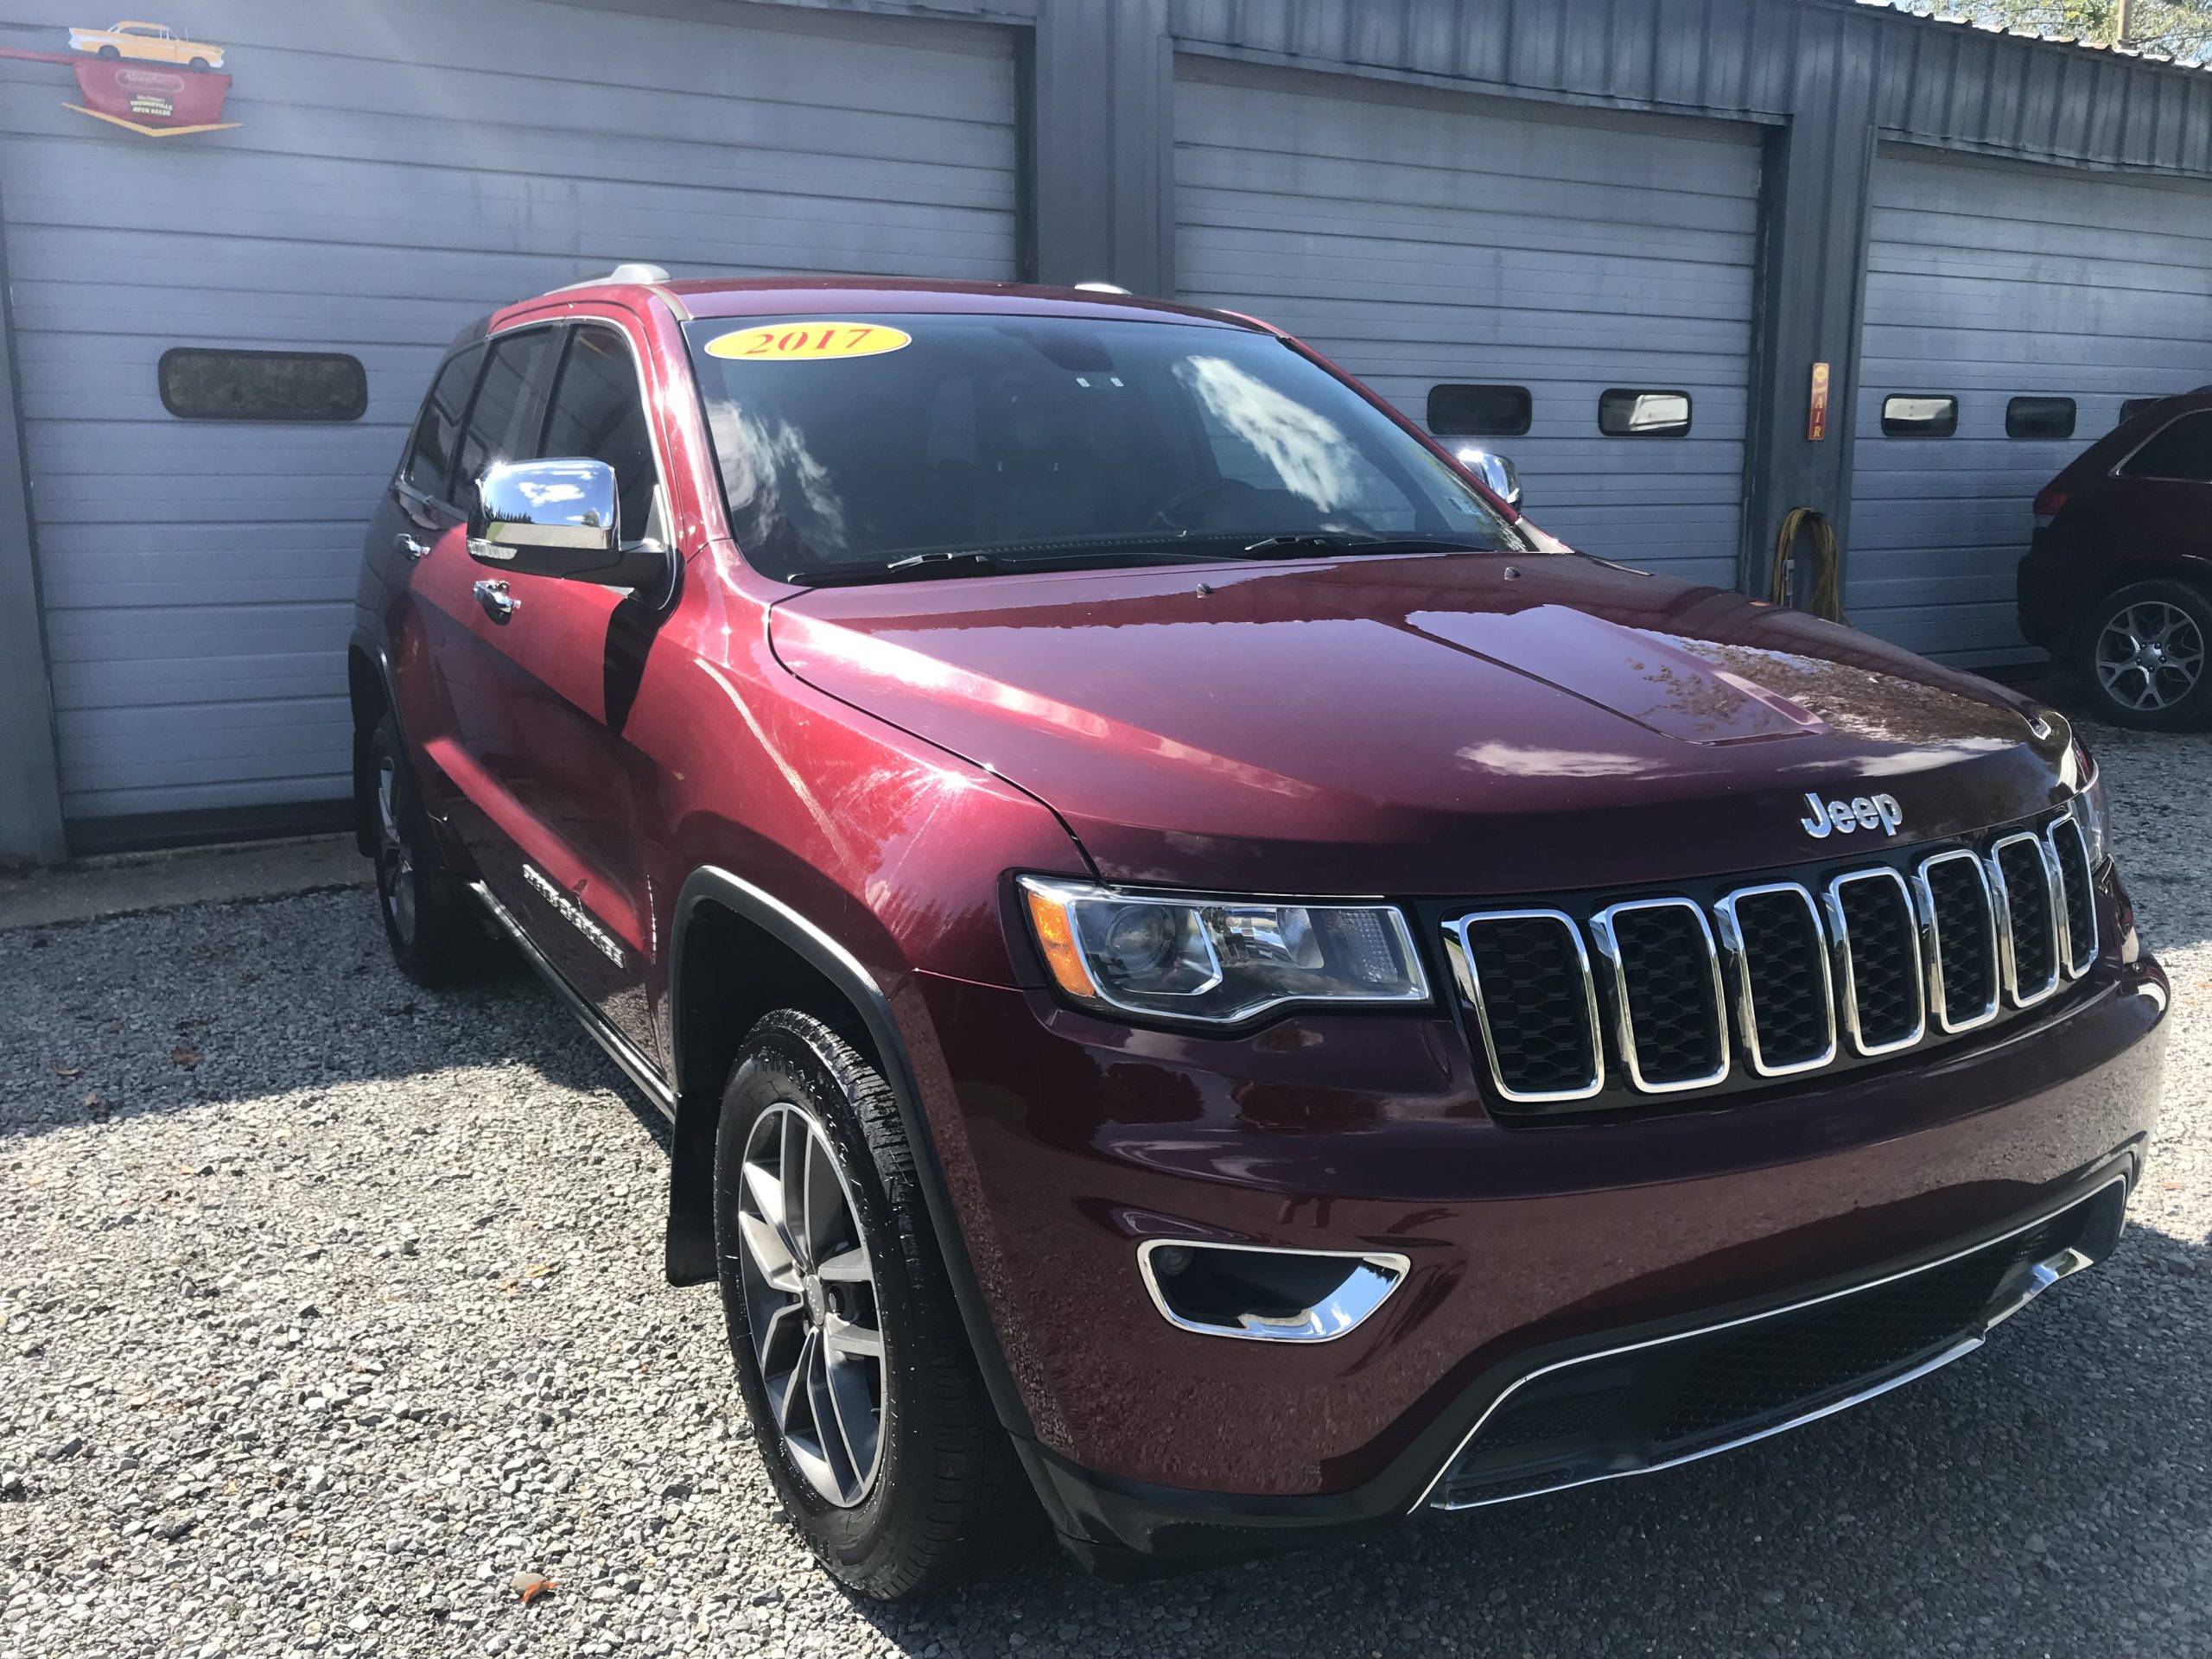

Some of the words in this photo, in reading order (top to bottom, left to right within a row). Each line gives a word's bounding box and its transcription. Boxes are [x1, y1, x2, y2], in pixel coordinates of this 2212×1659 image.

[744, 328, 874, 355] 2017
[1813, 397, 1823, 437] AIR
[1800, 792, 1904, 838] Jeep
